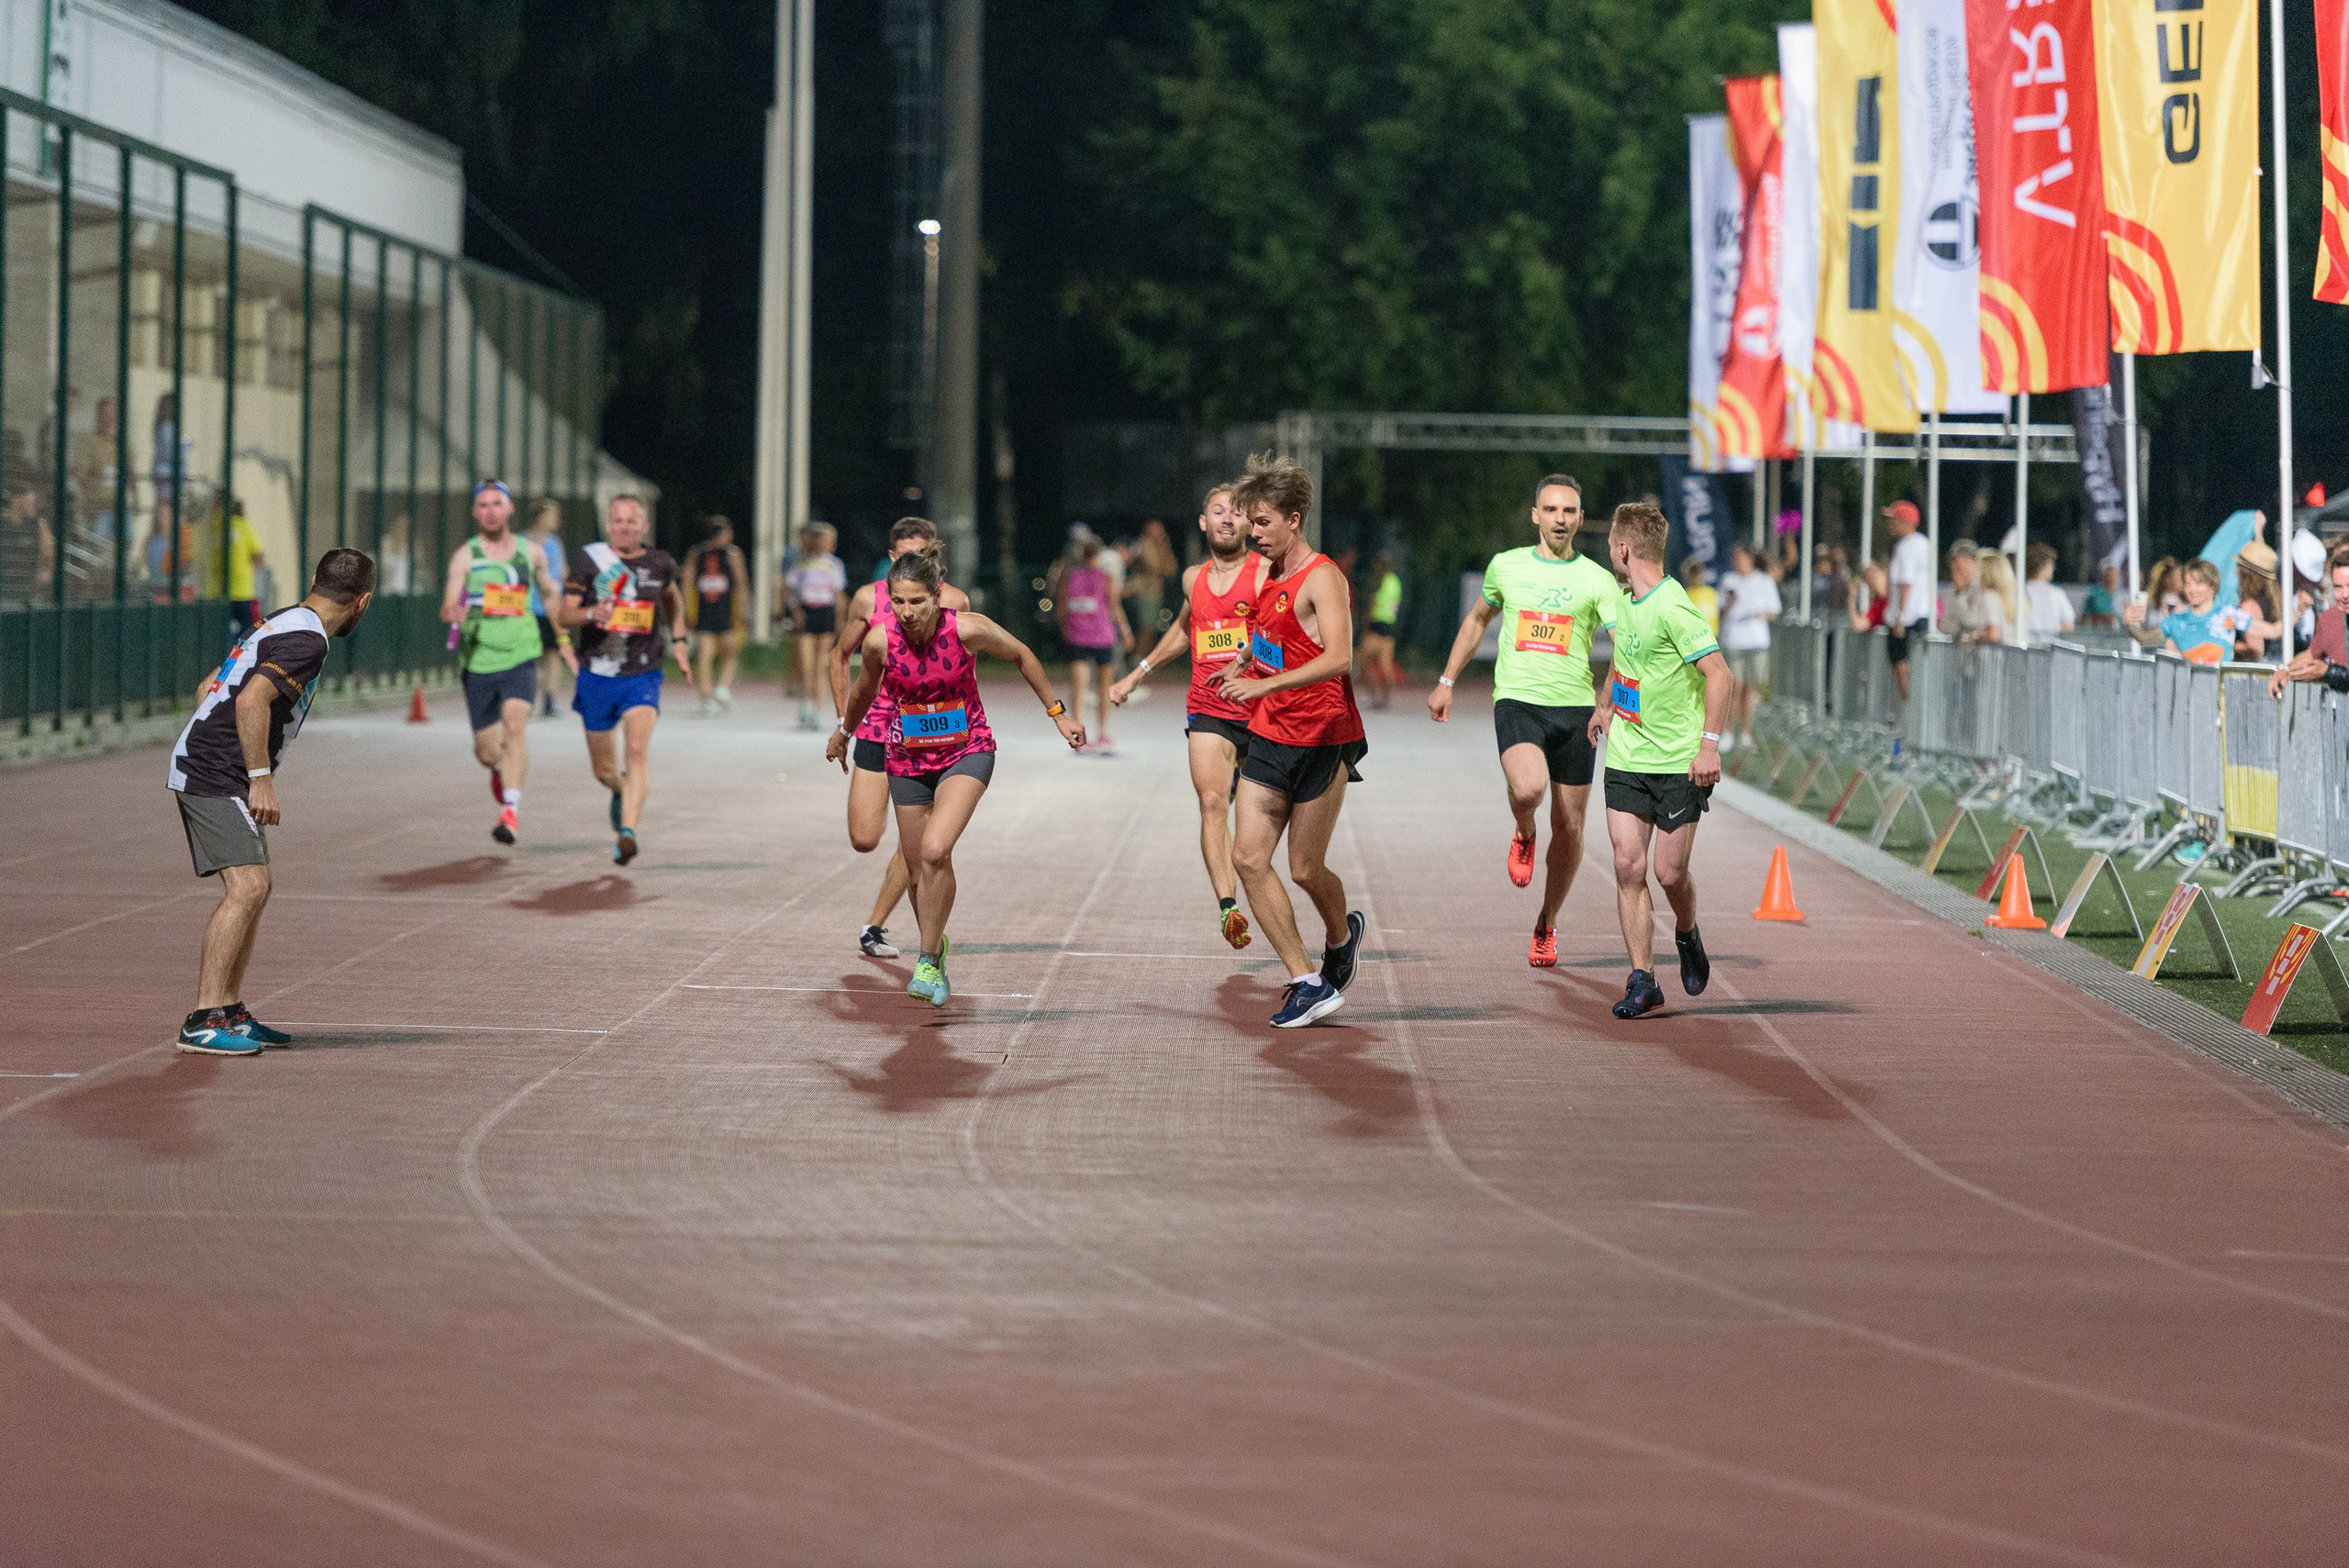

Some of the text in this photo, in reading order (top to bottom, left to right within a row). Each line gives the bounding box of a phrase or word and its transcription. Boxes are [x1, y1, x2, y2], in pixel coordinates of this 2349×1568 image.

[1531, 624, 1555, 639] 307
[1691, 628, 1709, 640] СБЕР
[1208, 633, 1232, 648] 308
[1258, 641, 1279, 664] 308 3
[1618, 688, 1636, 708] 307 3
[918, 716, 949, 732] 309
[954, 720, 961, 728] 3
